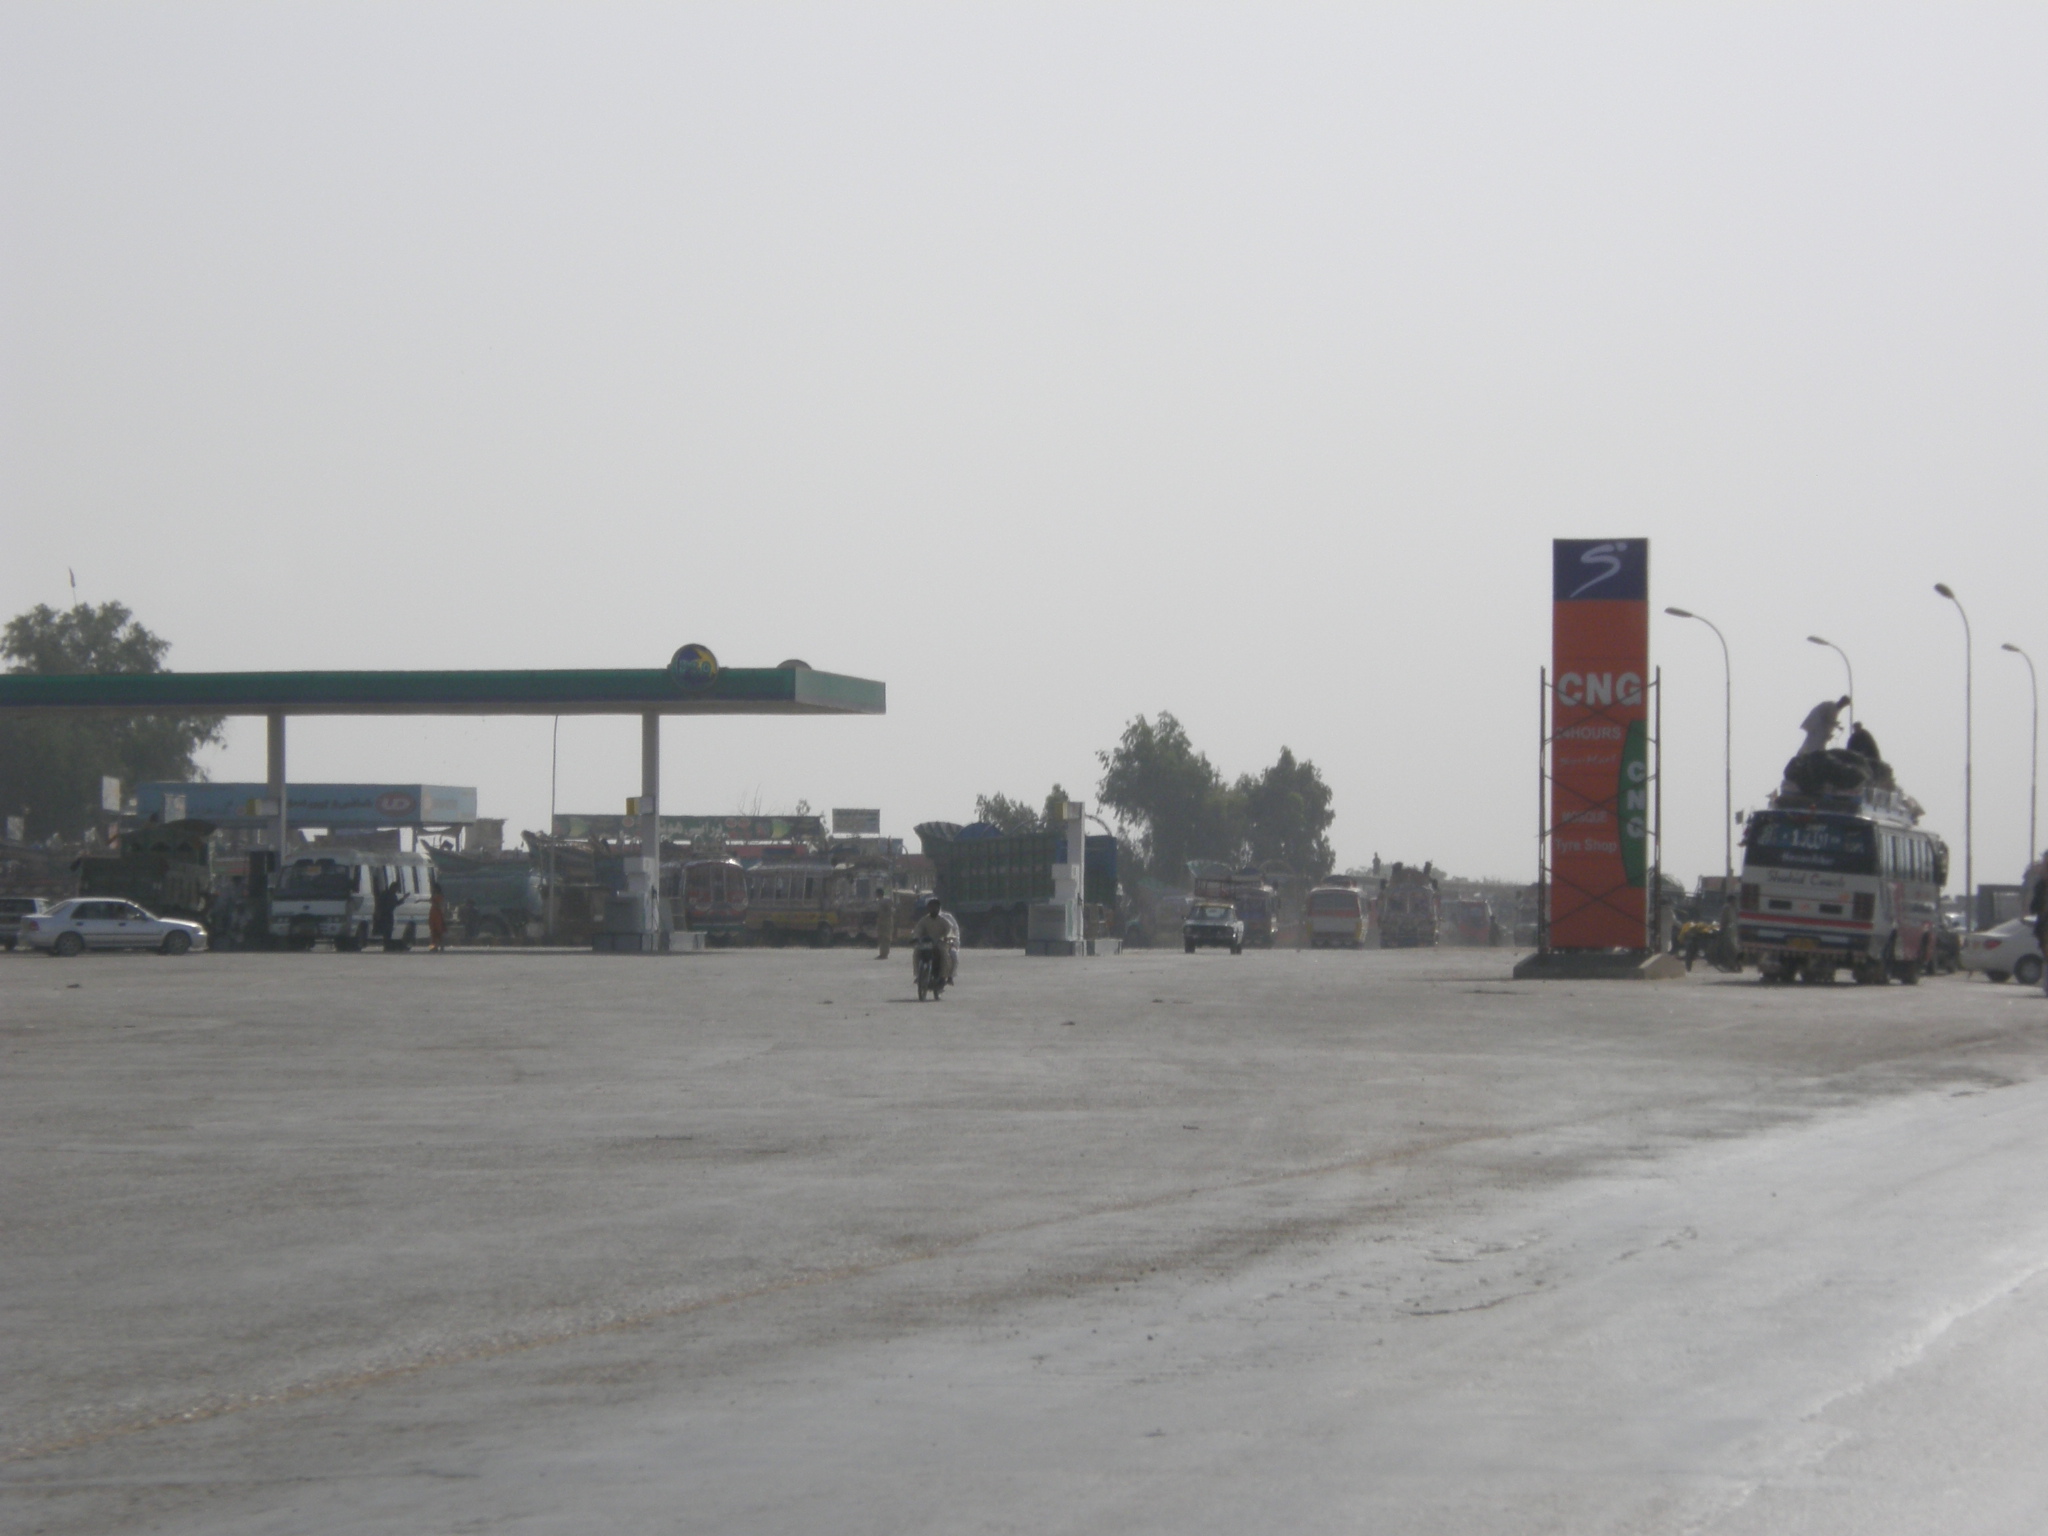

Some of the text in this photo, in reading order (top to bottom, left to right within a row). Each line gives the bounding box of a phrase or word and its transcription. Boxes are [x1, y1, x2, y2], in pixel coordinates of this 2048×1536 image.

[1558, 672, 1642, 707] CNG
[1626, 761, 1645, 838] CNG
[1556, 839, 1617, 853] Tyre Shop
